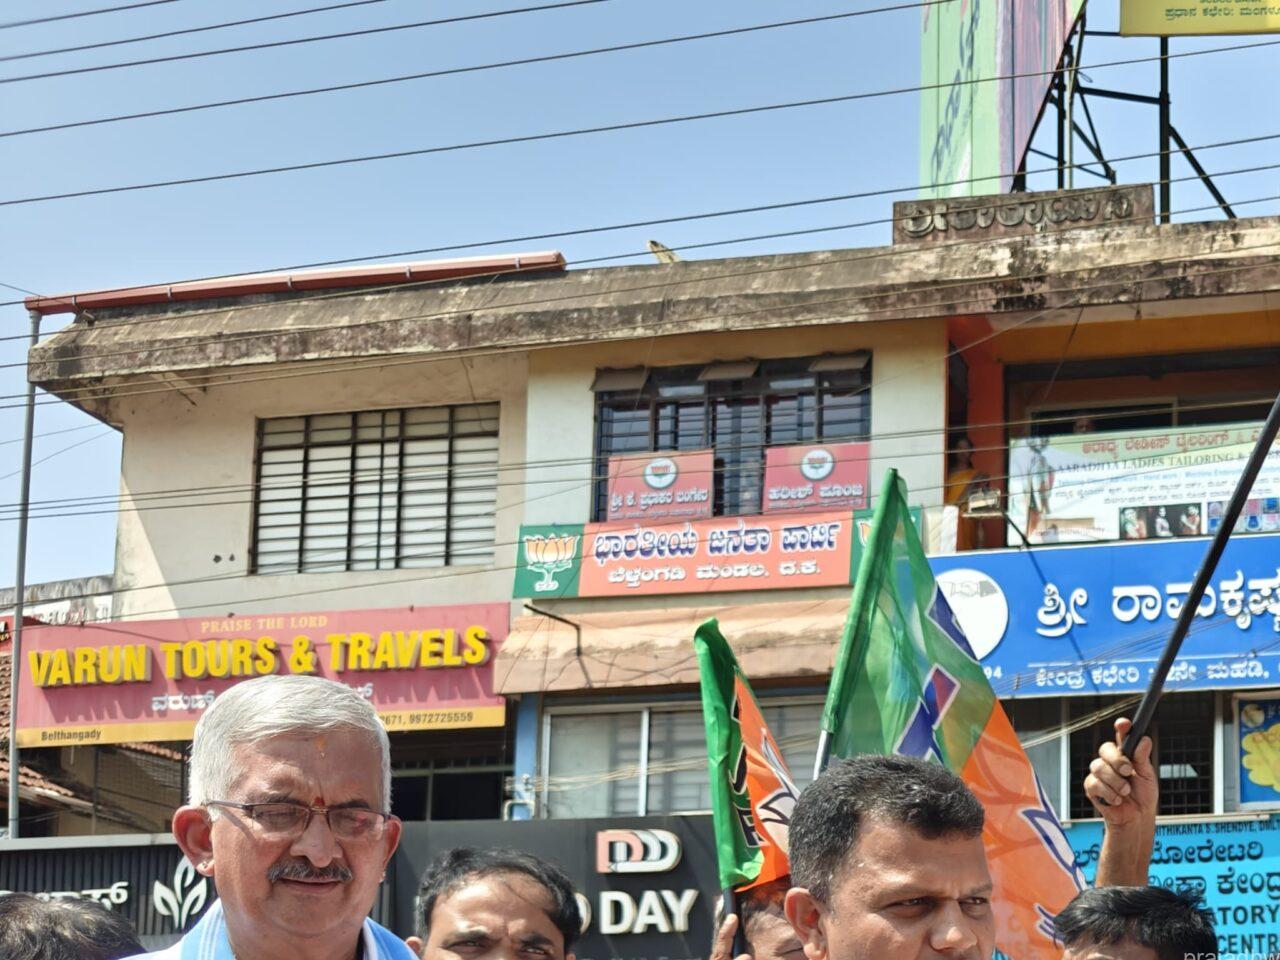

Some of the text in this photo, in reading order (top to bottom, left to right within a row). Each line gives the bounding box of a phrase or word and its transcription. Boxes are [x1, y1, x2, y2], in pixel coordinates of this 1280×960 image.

[1122, 457, 1164, 469] LADIES
[1169, 453, 1234, 468] TAILORING
[593, 517, 840, 566] ಭಾರತೀಯ ಜನತಾ ಪಾರ್ಟಿ
[1036, 581, 1089, 639] ಶ್ರೀ
[200, 615, 328, 633] PRAISE THE LORD
[27, 625, 490, 687] VARUN TOURS & TRAVELS
[1035, 667, 1086, 690] ಕೇಂದ್ರ
[41, 729, 102, 742] Belthangady
[600, 888, 700, 936] DAY
[1208, 904, 1280, 926] ATORY
